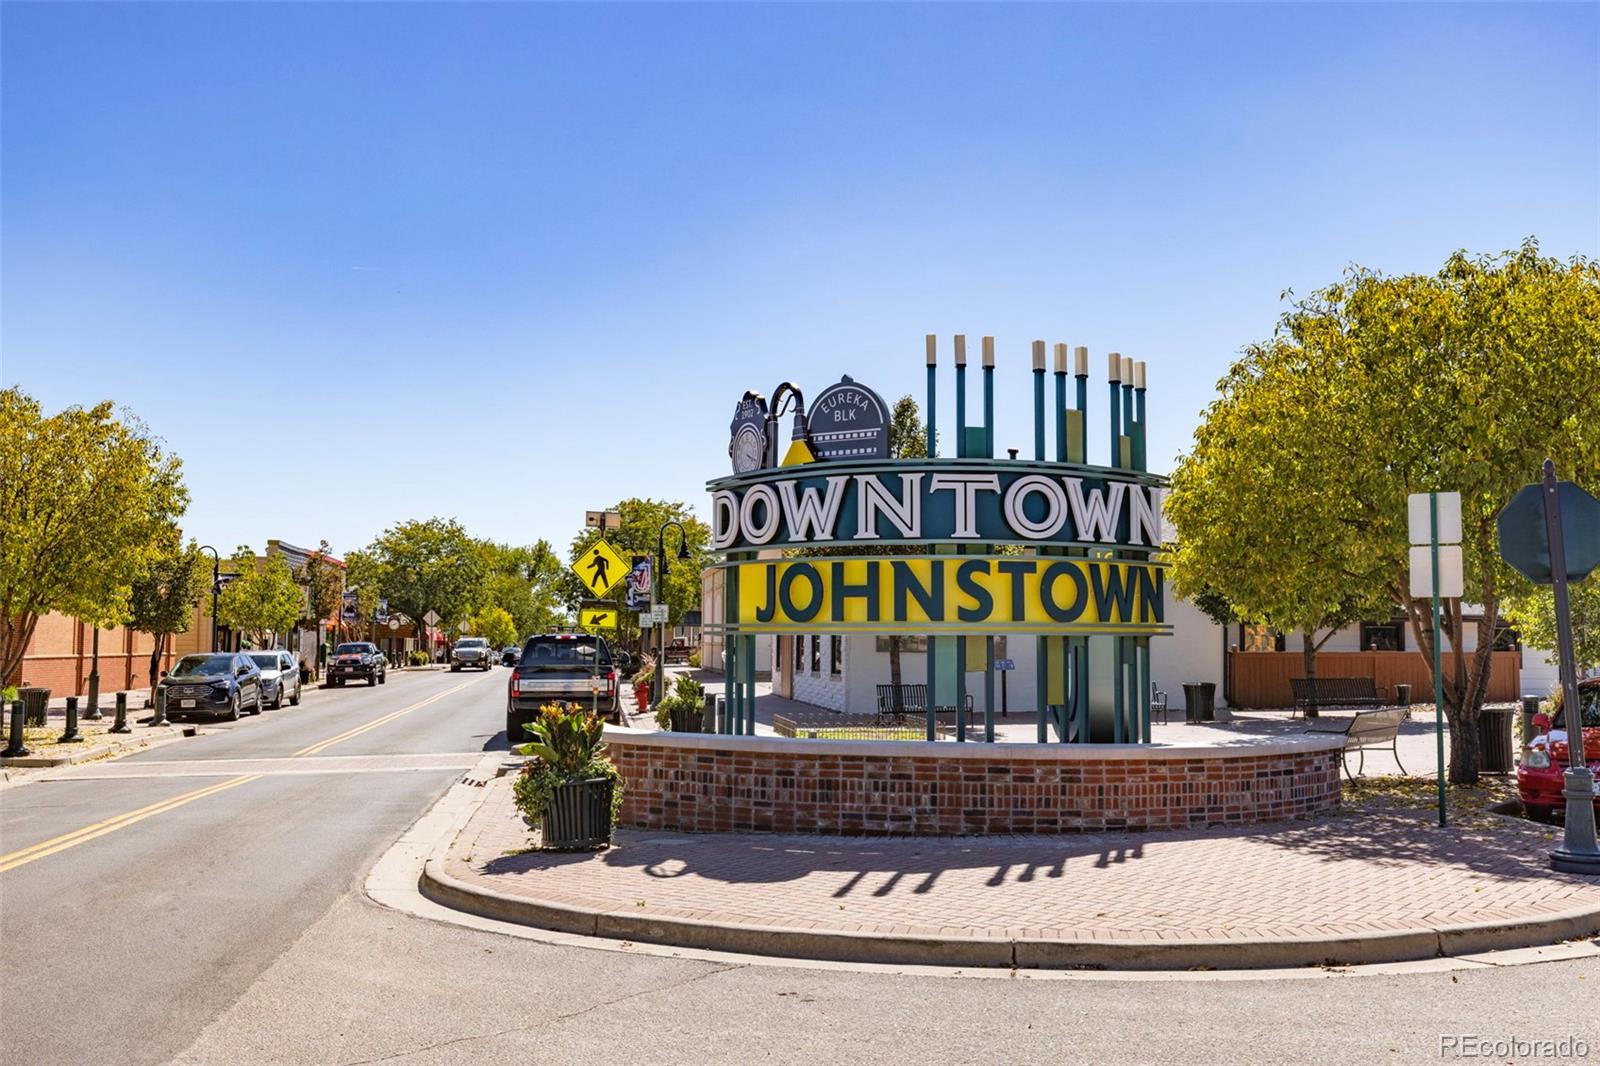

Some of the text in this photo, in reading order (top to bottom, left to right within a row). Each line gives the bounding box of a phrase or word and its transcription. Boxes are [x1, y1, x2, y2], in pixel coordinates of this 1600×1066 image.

[821, 392, 869, 414] EUREKA
[834, 408, 856, 422] BLK
[712, 473, 1162, 549] DOWNTOWN
[755, 560, 1165, 623] JOHNSTOWN
